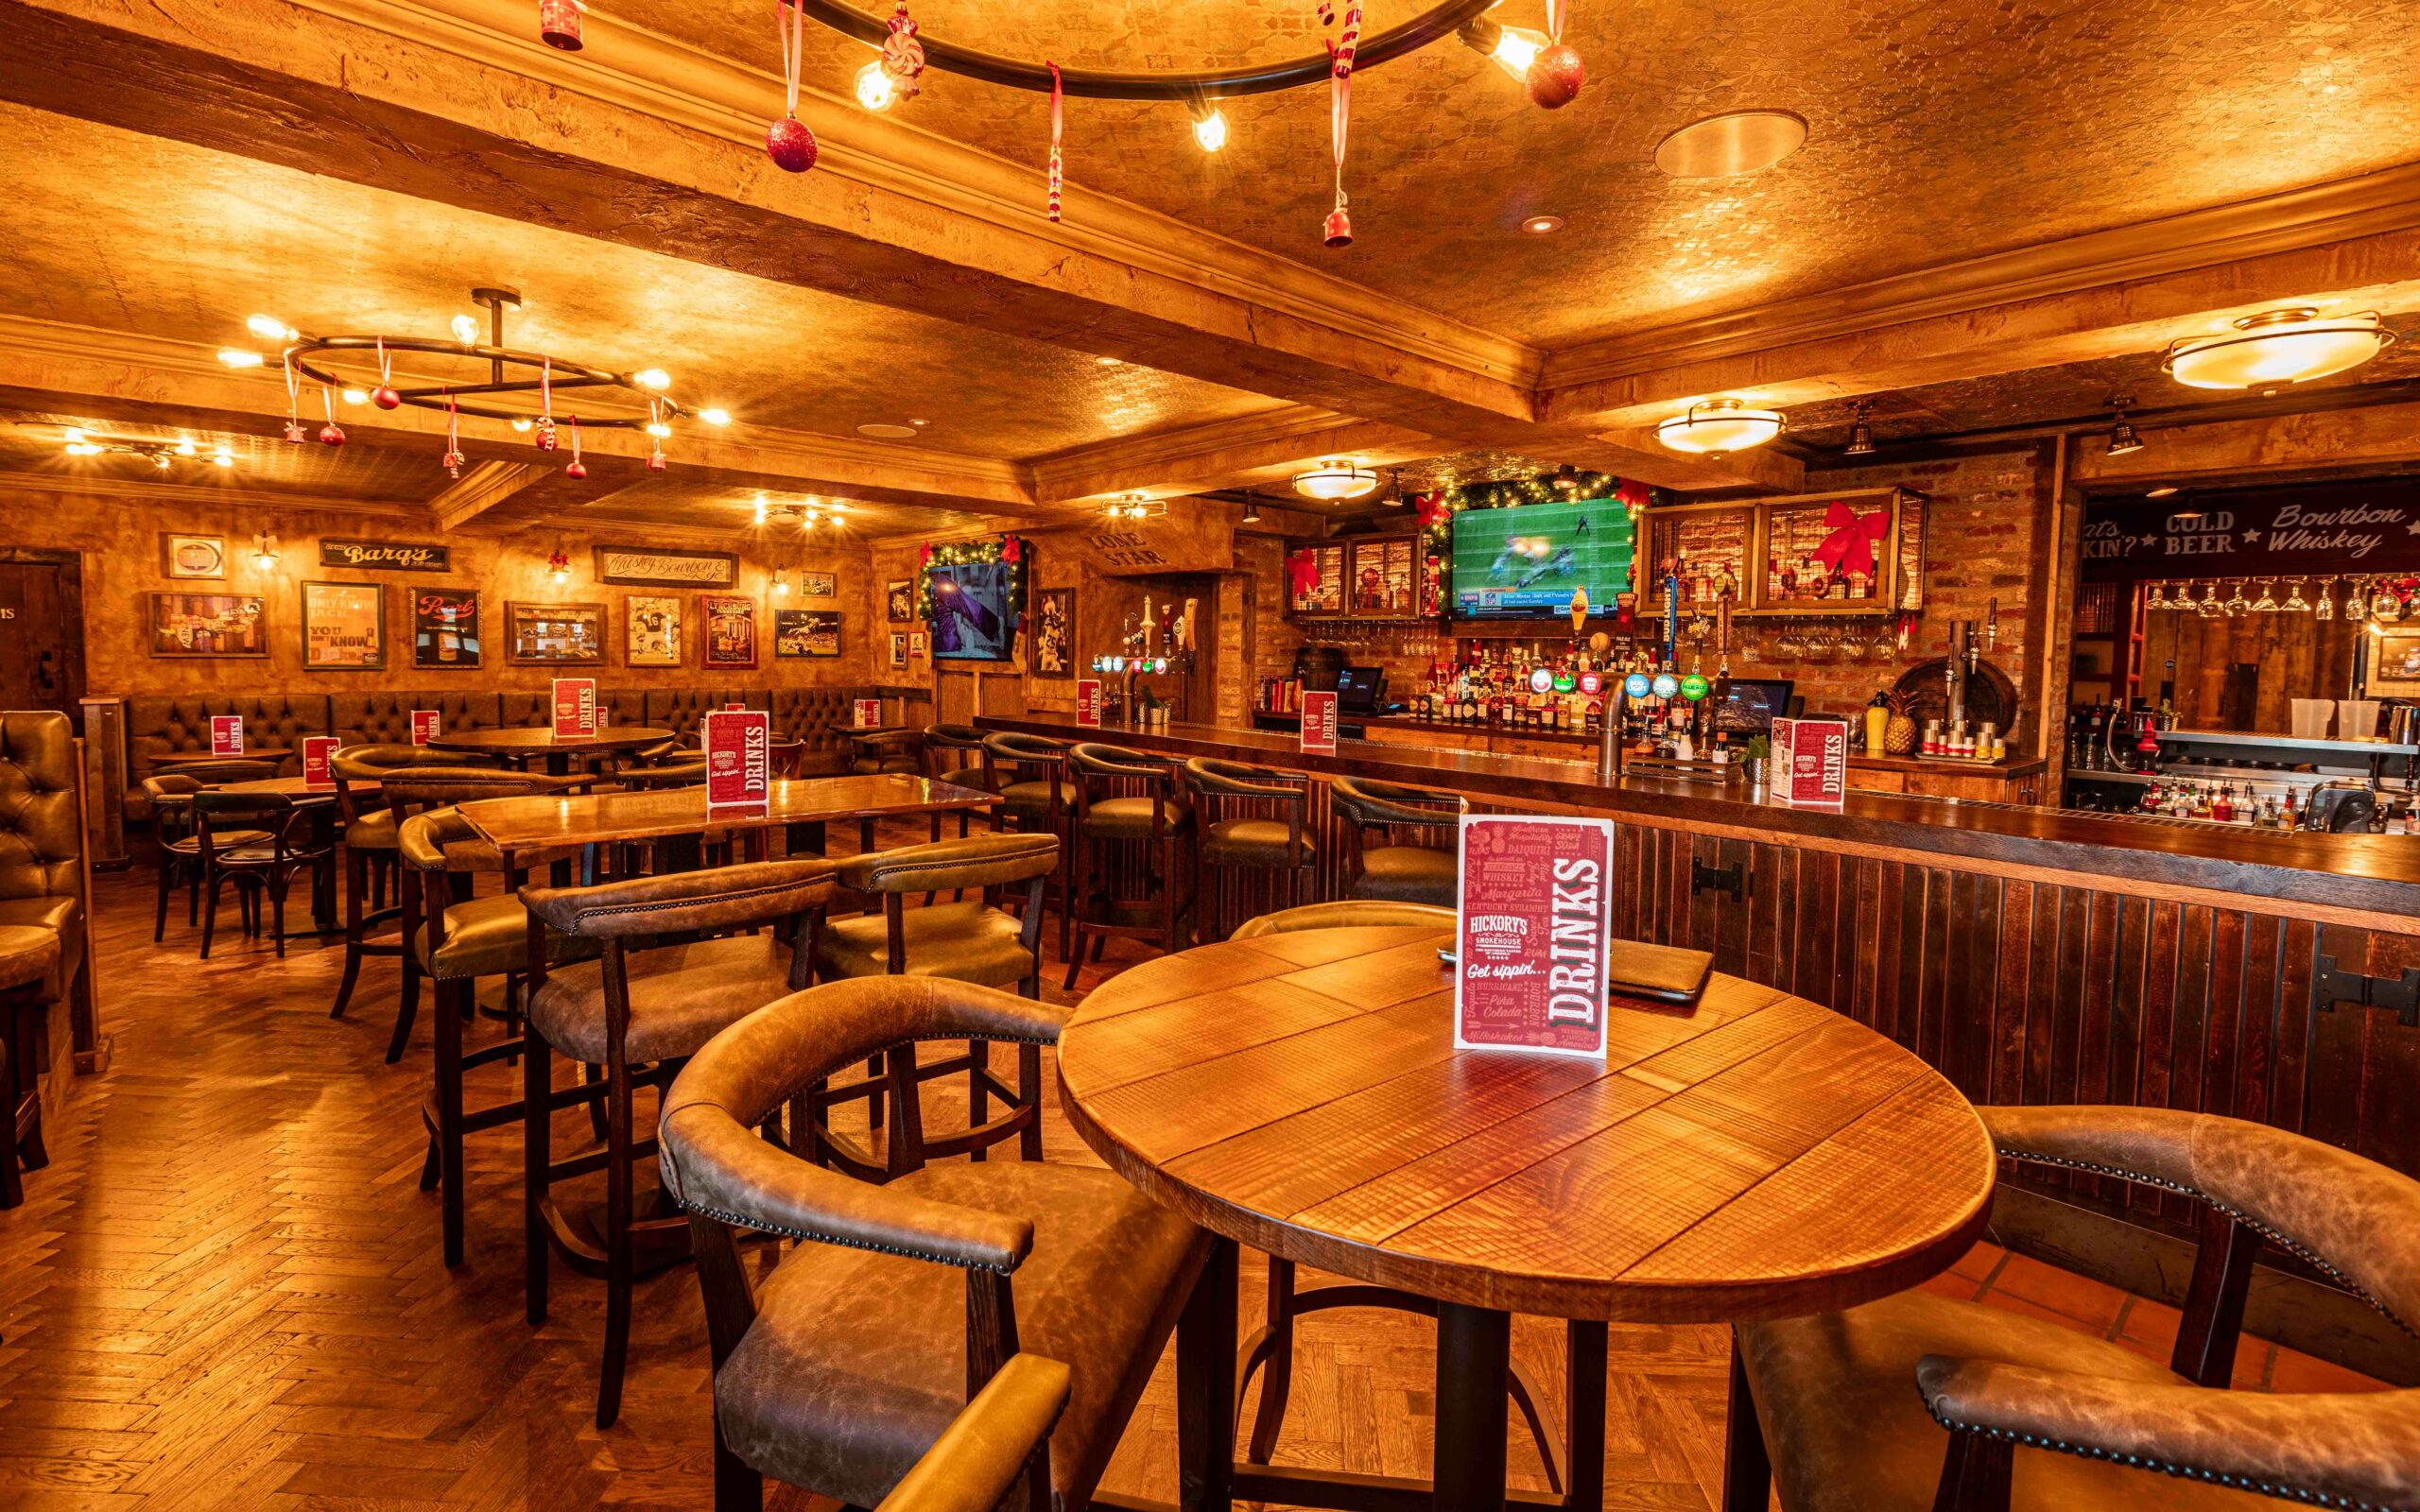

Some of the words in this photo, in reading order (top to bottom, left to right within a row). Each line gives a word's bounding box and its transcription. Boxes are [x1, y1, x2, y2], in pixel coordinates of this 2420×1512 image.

[2166, 511, 2235, 533] COLD
[2272, 504, 2407, 527] Bourbon
[1084, 532, 1147, 549] LONE
[2165, 534, 2236, 555] BEER
[2269, 529, 2383, 558] Whiskey
[344, 545, 434, 567] Barq's
[1104, 551, 1167, 565] STAR
[655, 558, 711, 576] Bourbon
[709, 601, 752, 610] LYNCHBURG
[310, 626, 342, 635] YOU
[330, 636, 368, 647] KNOW
[1046, 634, 1056, 649] 25
[579, 688, 592, 729] DRINKS
[1322, 700, 1334, 740] DRINKS
[231, 721, 241, 748] DRINKS
[745, 726, 765, 791] DRINKS
[1822, 734, 1843, 793] DRINKS
[1555, 840, 1580, 850] SODA
[1556, 832, 1581, 842] GRAPE
[1467, 846, 1490, 855] TEXAS
[1507, 844, 1551, 856] DAIQUIRI
[1482, 871, 1526, 883] WHISKEY
[1481, 888, 1543, 902] Margarita
[1465, 902, 1509, 912] KENTUCKY
[1510, 903, 1549, 914] STRAIGHT
[1470, 915, 1529, 936] HICKORY'S
[1525, 915, 1538, 946] Sweet
[1537, 917, 1550, 936] Tea
[1476, 936, 1522, 946] SMOKEHOUSE
[1548, 858, 1599, 1023] DRINKS
[1524, 948, 1547, 958] RUM
[1467, 963, 1491, 979] Get
[1477, 982, 1524, 992] HURRICANE
[1464, 983, 1477, 1019] Tequila
[1490, 994, 1515, 1006] Piña
[1530, 982, 1541, 1027] BOURBON
[1483, 1006, 1523, 1019] Colada
[1464, 1030, 1524, 1042] Milkshakes
